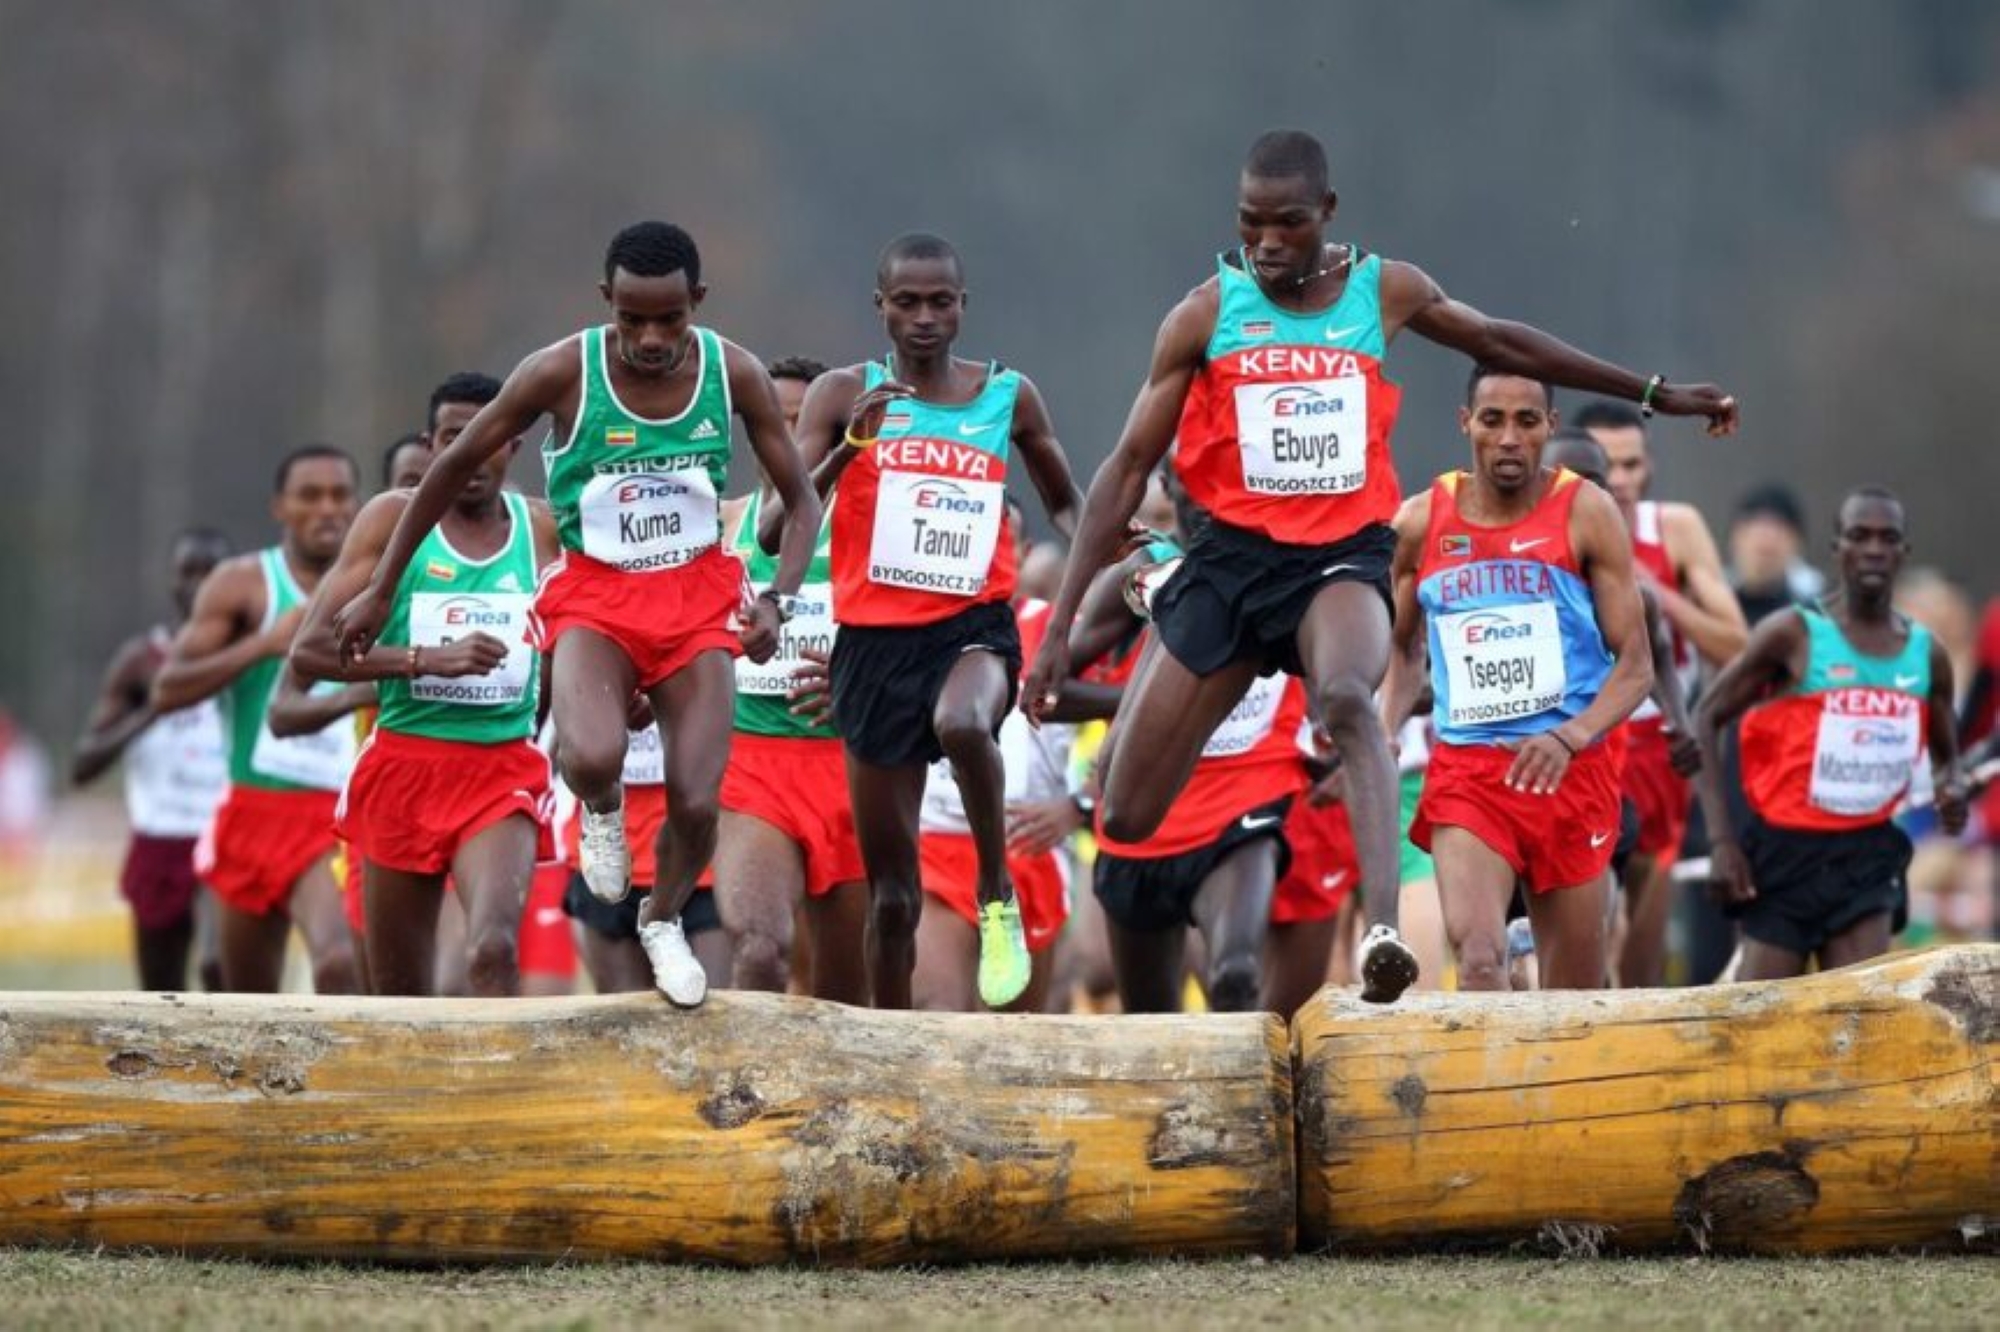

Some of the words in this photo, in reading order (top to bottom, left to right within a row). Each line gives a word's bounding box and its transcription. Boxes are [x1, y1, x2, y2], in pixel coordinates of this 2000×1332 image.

[1239, 348, 1361, 377] KENYA
[1274, 398, 1343, 416] Enea
[876, 439, 989, 480] KENYA
[1272, 428, 1339, 468] Ebuya
[618, 483, 688, 503] Enea
[1247, 474, 1338, 491] BYDGOSZCZ
[916, 488, 985, 515] Enea
[618, 511, 681, 543] Kuma
[912, 518, 972, 559] Tanui
[612, 550, 681, 570] GOSZCZ
[872, 564, 965, 590] BYDGOSZCZ
[1440, 564, 1555, 604] ERITREA
[446, 606, 511, 625] Enea
[1466, 622, 1532, 644] Enea
[1463, 655, 1535, 694] Tsegay
[412, 684, 498, 699] BYDGOSZCZ
[1452, 700, 1530, 722] BYDGOSZCZ
